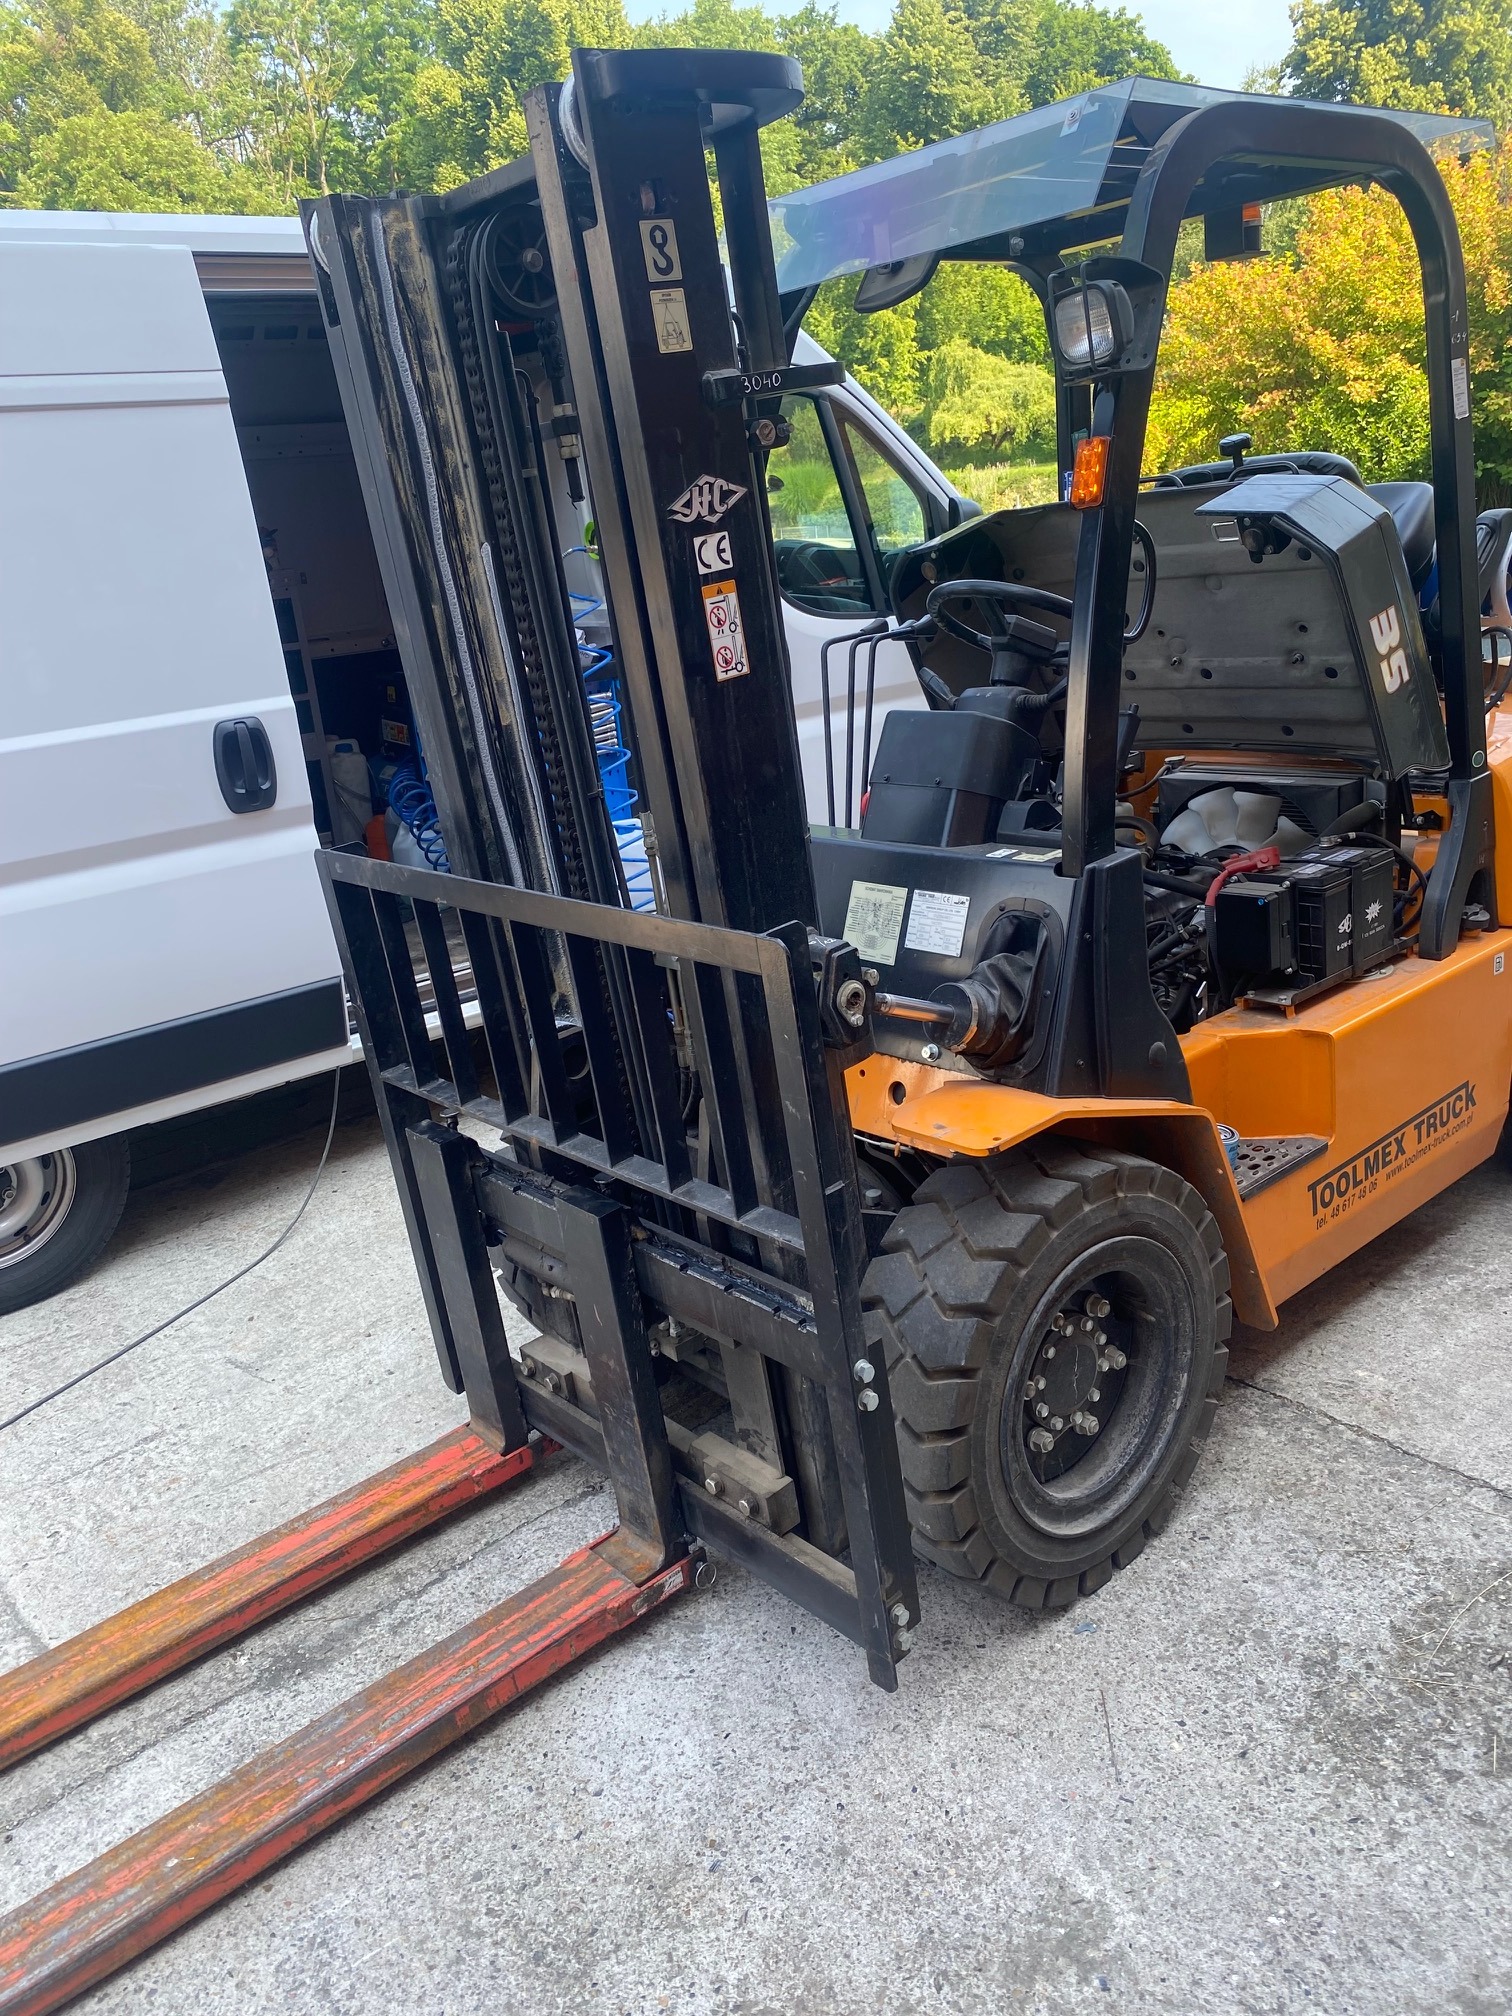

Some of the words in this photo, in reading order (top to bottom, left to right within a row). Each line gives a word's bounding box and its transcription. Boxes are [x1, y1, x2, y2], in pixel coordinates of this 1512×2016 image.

[740, 372, 782, 393] 3040
[697, 534, 730, 570] CE
[1368, 604, 1410, 695] 35
[1307, 1130, 1406, 1217] TOOLMEX
[1413, 1080, 1477, 1145] TRUCK
[1316, 1212, 1328, 1231] tel.
[1330, 1204, 1340, 1220] 48
[1341, 1193, 1356, 1213] 617
[1357, 1186, 1367, 1200] 48
[1385, 1110, 1474, 1181] www.toolmex-truck.com.pl
